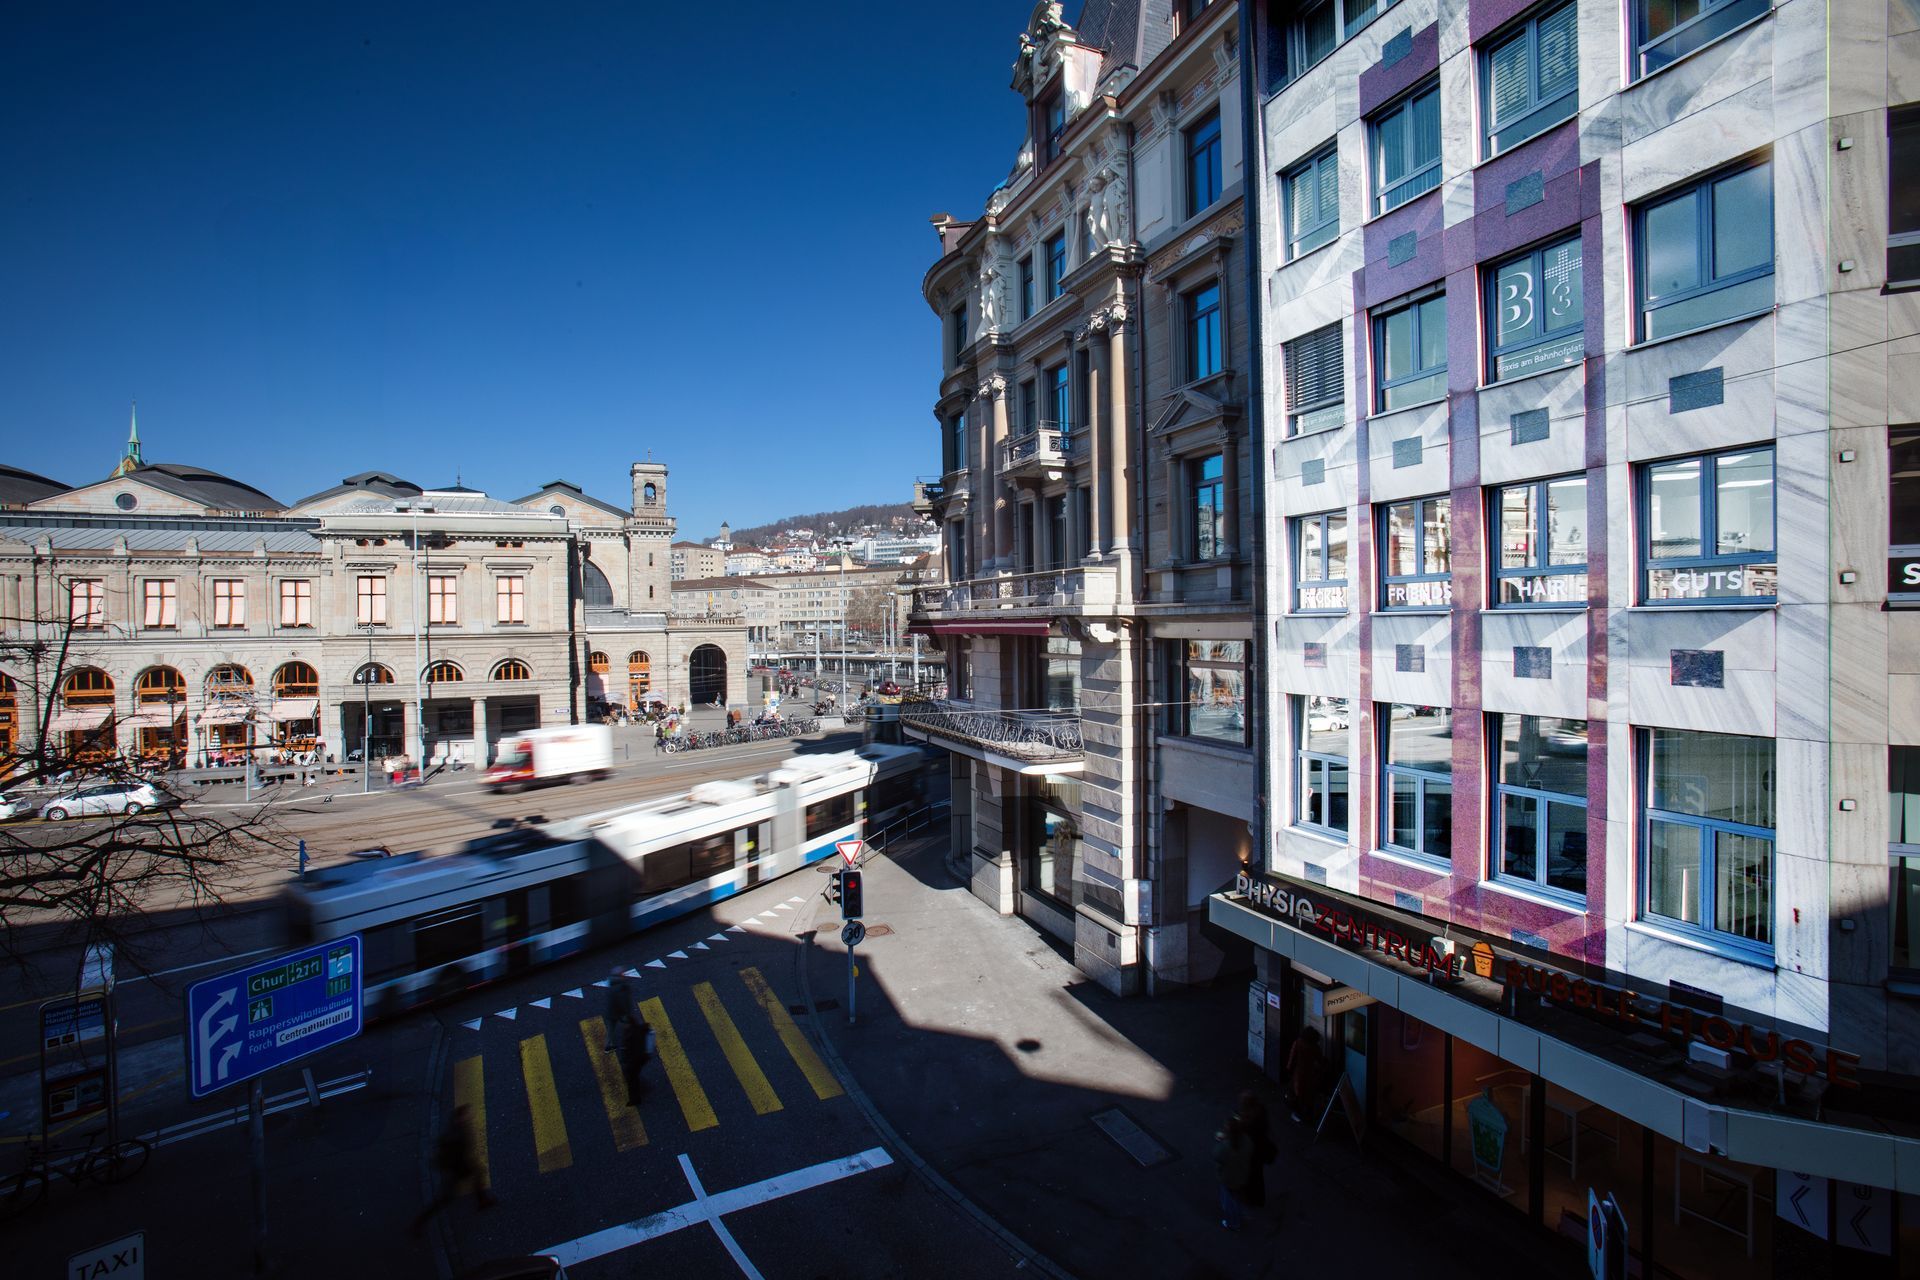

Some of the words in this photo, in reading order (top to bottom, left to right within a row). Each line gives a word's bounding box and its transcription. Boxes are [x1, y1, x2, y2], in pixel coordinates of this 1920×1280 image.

[1520, 357, 1533, 367] am
[1389, 584, 1452, 601] FRIENDS
[1518, 579, 1565, 597] HAIR
[1673, 571, 1741, 591] CUTS
[847, 926, 861, 940] 30
[251, 972, 285, 992] Chur
[248, 1038, 274, 1056] Forch
[1661, 1002, 1862, 1090] HOUSE
[76, 1247, 137, 1280] TAXI
